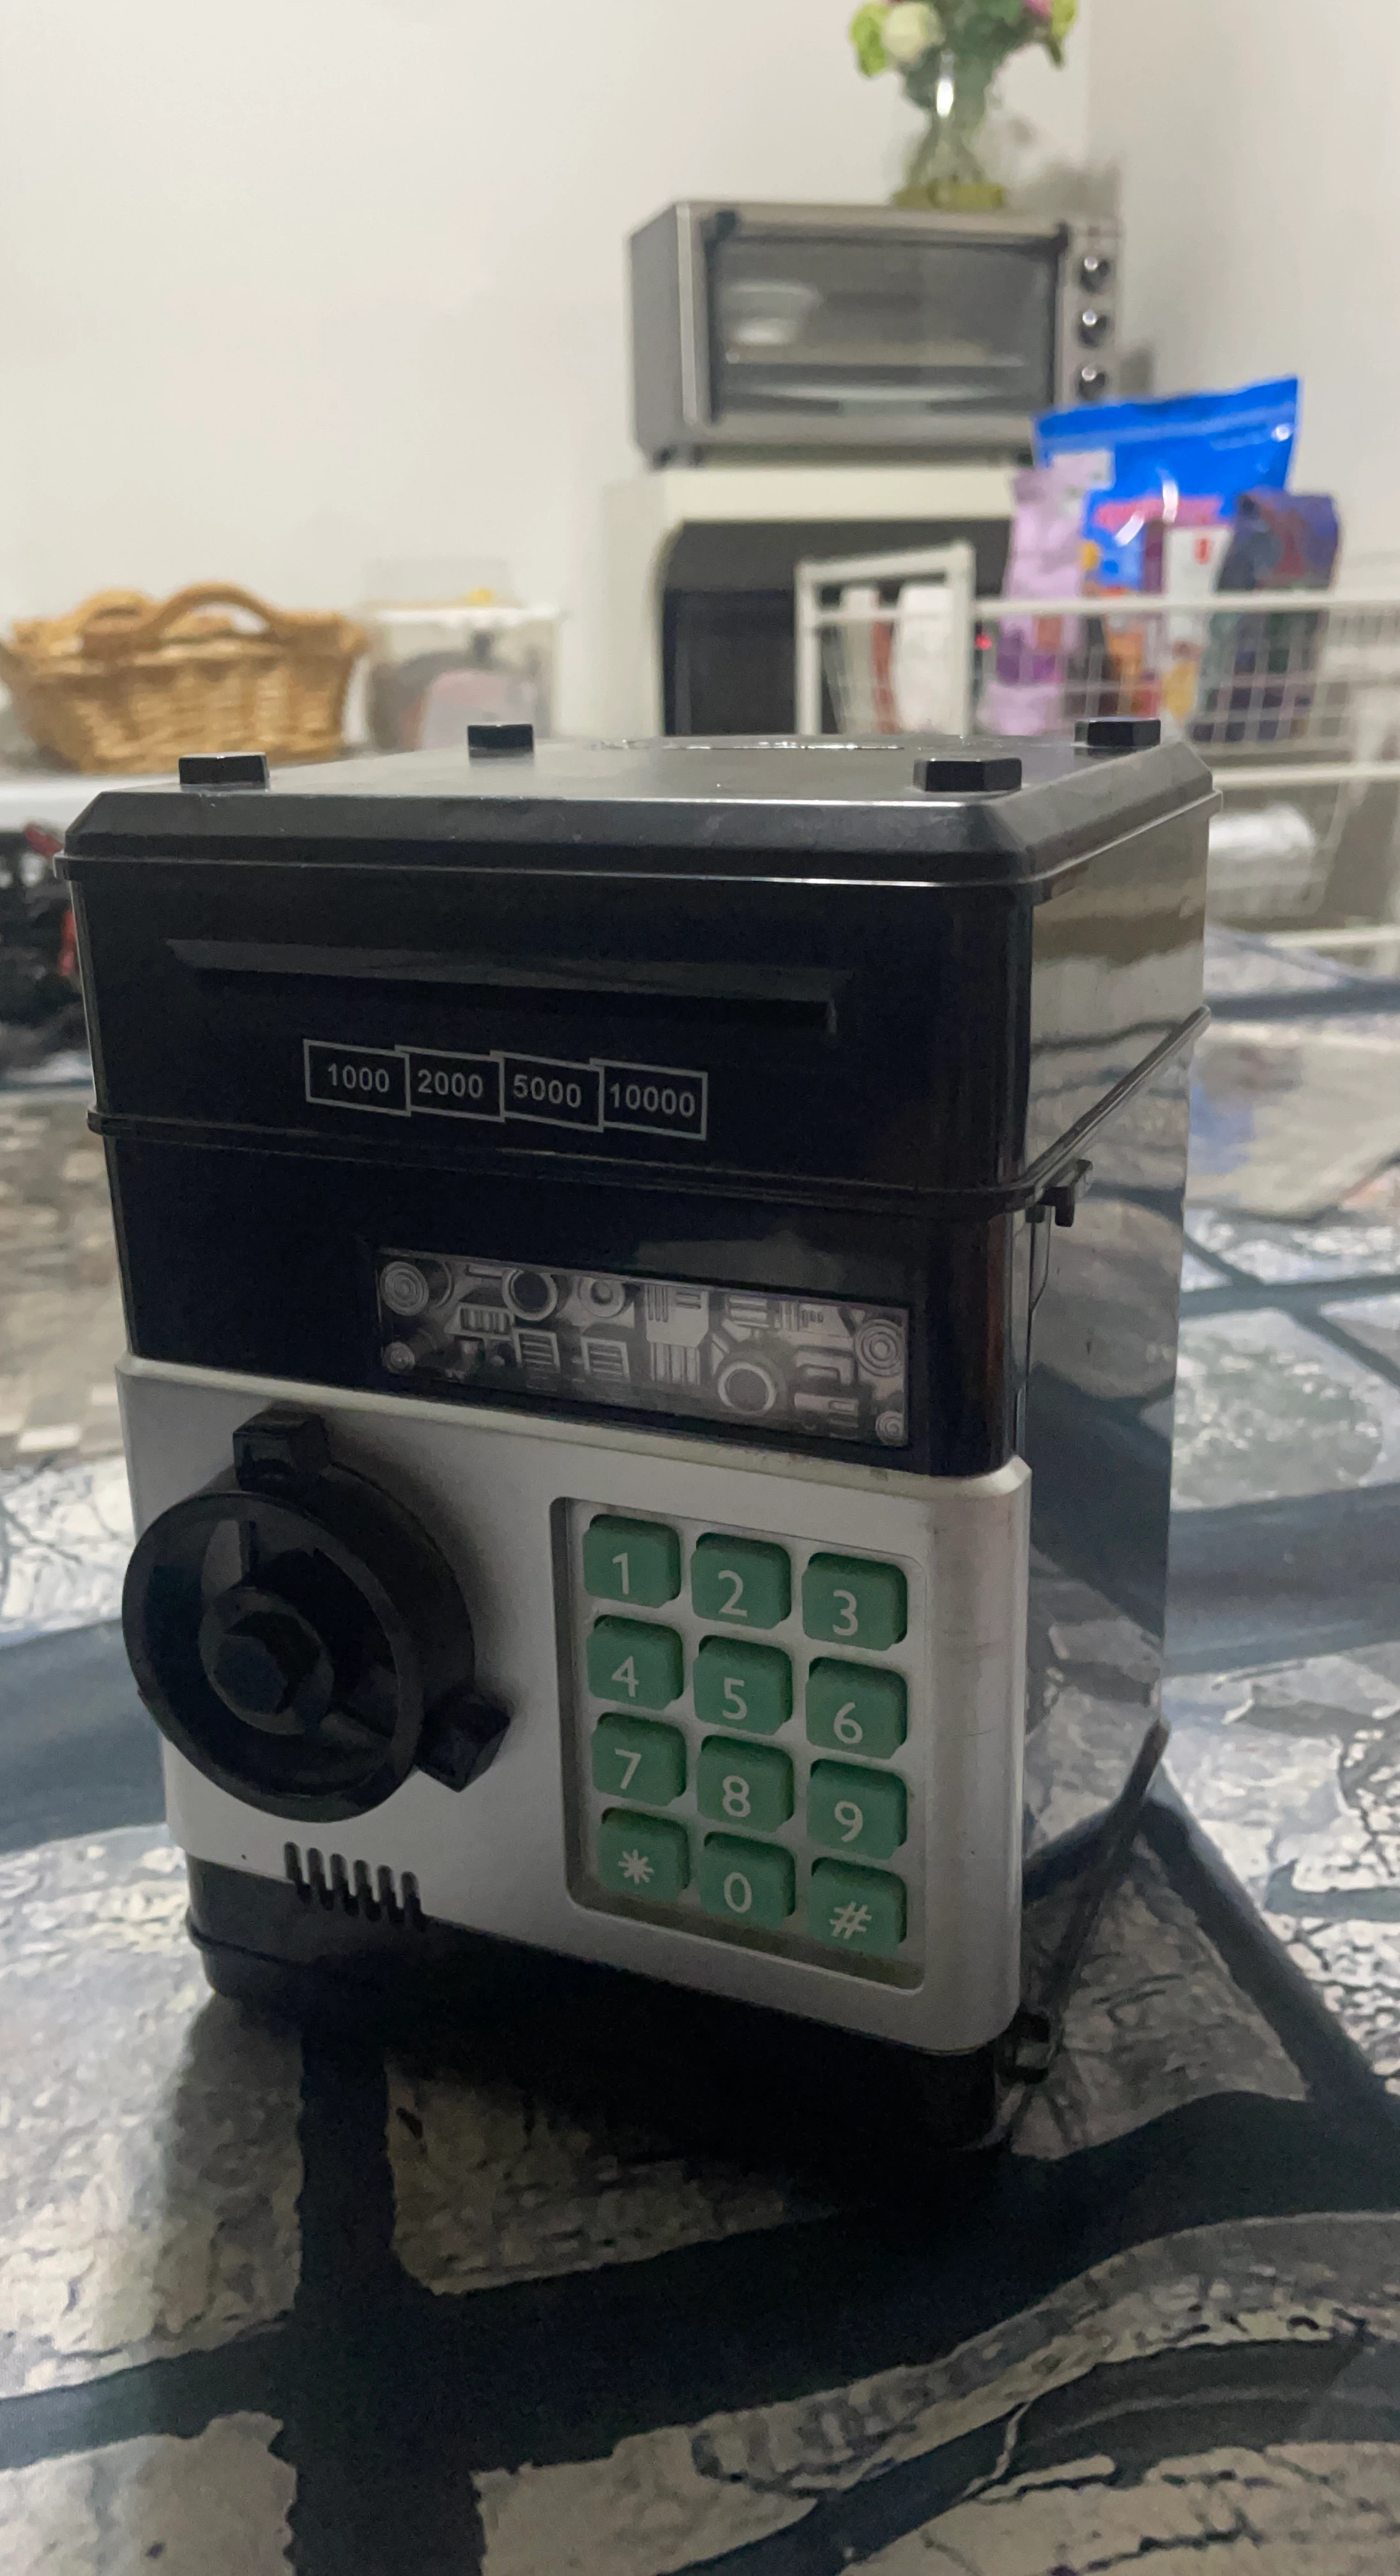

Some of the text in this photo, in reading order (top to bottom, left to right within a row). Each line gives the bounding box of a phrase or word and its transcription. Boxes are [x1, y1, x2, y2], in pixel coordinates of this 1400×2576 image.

[327, 1062, 696, 1118] 1000 2000 5000 10000
[611, 1552, 859, 1637] 1 2 3
[611, 1655, 863, 1744] 4 5 6
[614, 1748, 864, 1843] 7 8 9
[723, 1871, 752, 1913] 0
[829, 1901, 872, 1940] #
